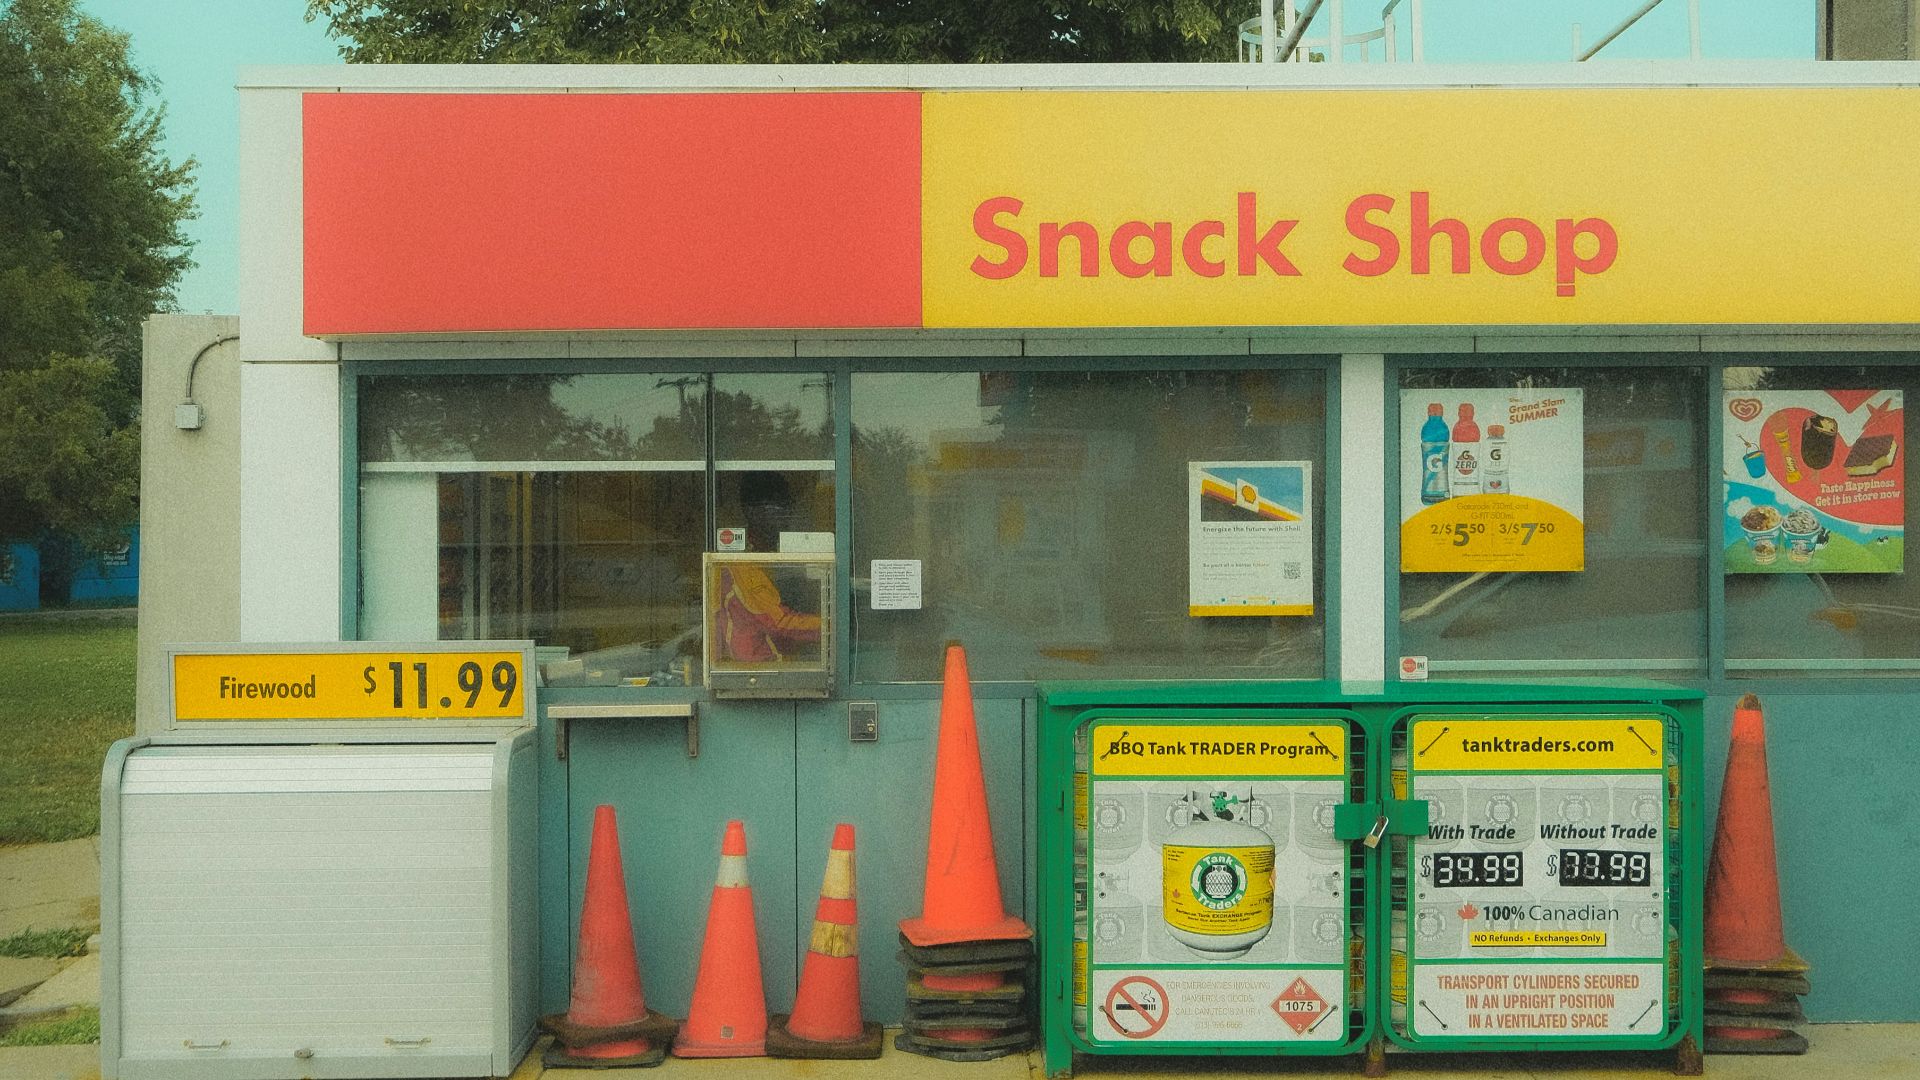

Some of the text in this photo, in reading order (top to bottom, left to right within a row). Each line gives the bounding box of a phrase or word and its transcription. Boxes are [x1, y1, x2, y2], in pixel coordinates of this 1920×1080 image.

[970, 191, 1619, 297] Snack Shop
[1508, 398, 1566, 413] Grand Slam
[1509, 407, 1558, 425] SUMMER
[1455, 460, 1478, 469] ZERO
[1820, 479, 1895, 493] Taste Happiness
[1815, 490, 1901, 507] Get it in store now
[219, 674, 316, 699] Firewood
[1110, 740, 1330, 759] BBQ Tank TRADER Program
[1461, 736, 1615, 753] tanktraders.com
[1428, 824, 1516, 840] With Trade
[1539, 824, 1657, 840] Without Trade
[1202, 855, 1234, 866] Tank
[1198, 893, 1242, 911] Traders
[1483, 905, 1525, 921] 100%
[1528, 904, 1619, 921] Canadian
[1474, 934, 1601, 943] NO Refunds Exchanges Only
[1437, 974, 1640, 990] TRANSPORT CYLINDERS SECURED
[1285, 1001, 1314, 1012] 1075
[1465, 994, 1615, 1009] IN AN UPRIGHT POSITION
[1297, 1023, 1303, 1032] 2
[1468, 1013, 1608, 1029] IN A VENTILATED SPACE
